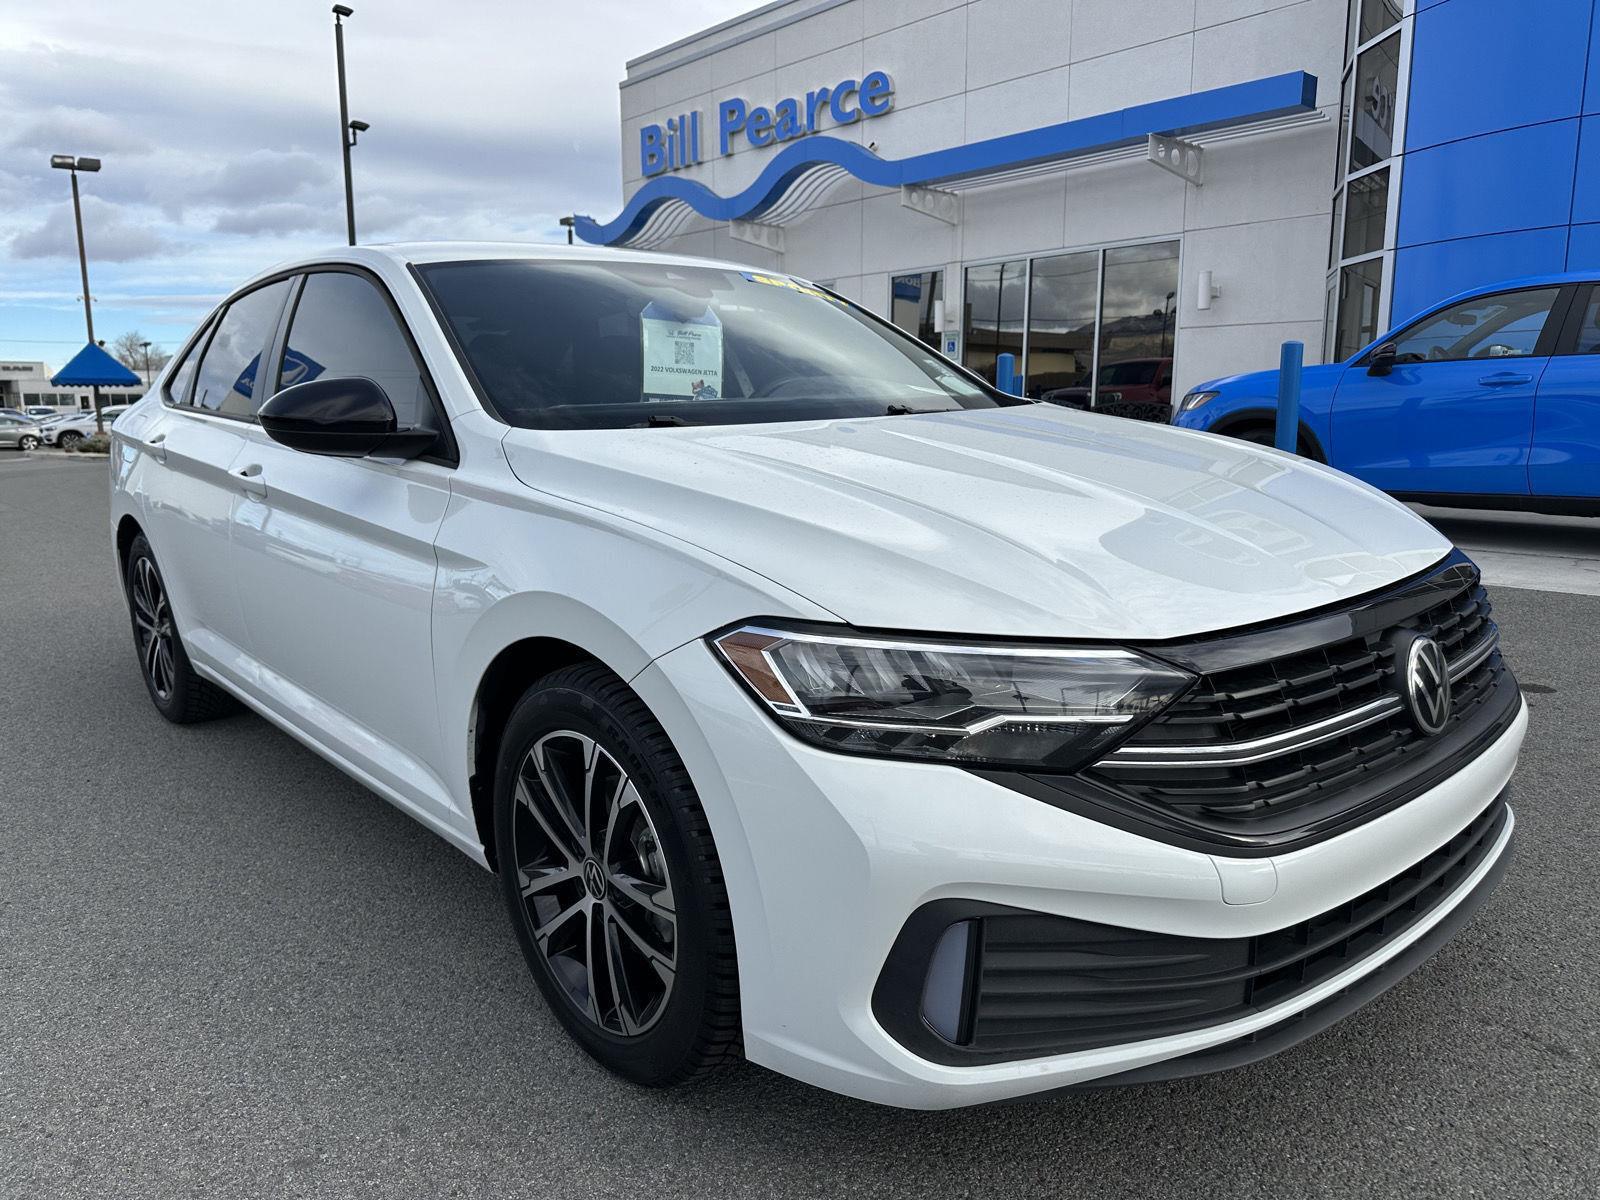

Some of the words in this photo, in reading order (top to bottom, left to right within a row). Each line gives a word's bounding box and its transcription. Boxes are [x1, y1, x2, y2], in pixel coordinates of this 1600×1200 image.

[640, 110, 700, 177] Bill
[719, 71, 893, 156] Pearce
[665, 367, 702, 376] VOLKSWAGEN
